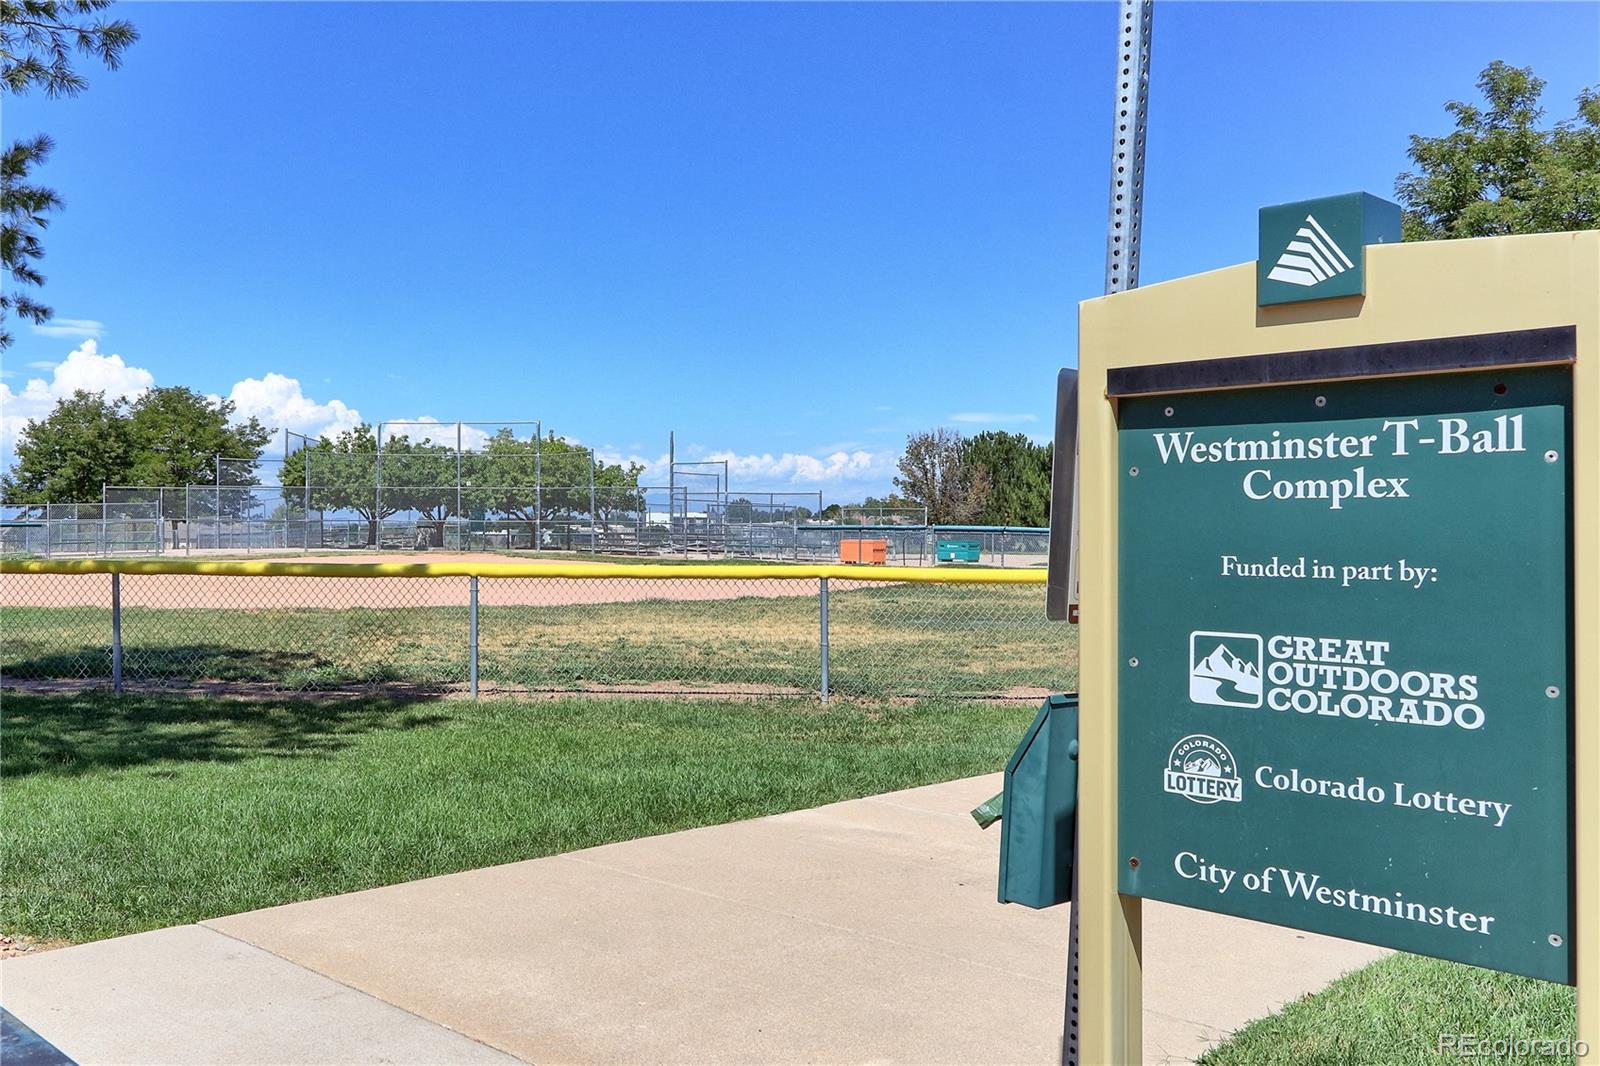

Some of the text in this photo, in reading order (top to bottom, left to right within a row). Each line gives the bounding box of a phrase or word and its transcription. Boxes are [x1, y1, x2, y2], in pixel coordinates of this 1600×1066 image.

[1153, 414, 1526, 464] Westminster T-Ball
[1242, 466, 1409, 510] Complex
[1220, 555, 1438, 589] Funded in part by:
[1267, 635, 1390, 666] GREAT
[1267, 661, 1478, 701] OUTDOORS
[1267, 687, 1485, 730] COLORADO
[1178, 740, 1227, 761] COLORADO
[1167, 774, 1239, 799] LOTTERY
[1254, 766, 1513, 828] Colorado Lottery
[1174, 851, 1496, 935] City of Westminster
